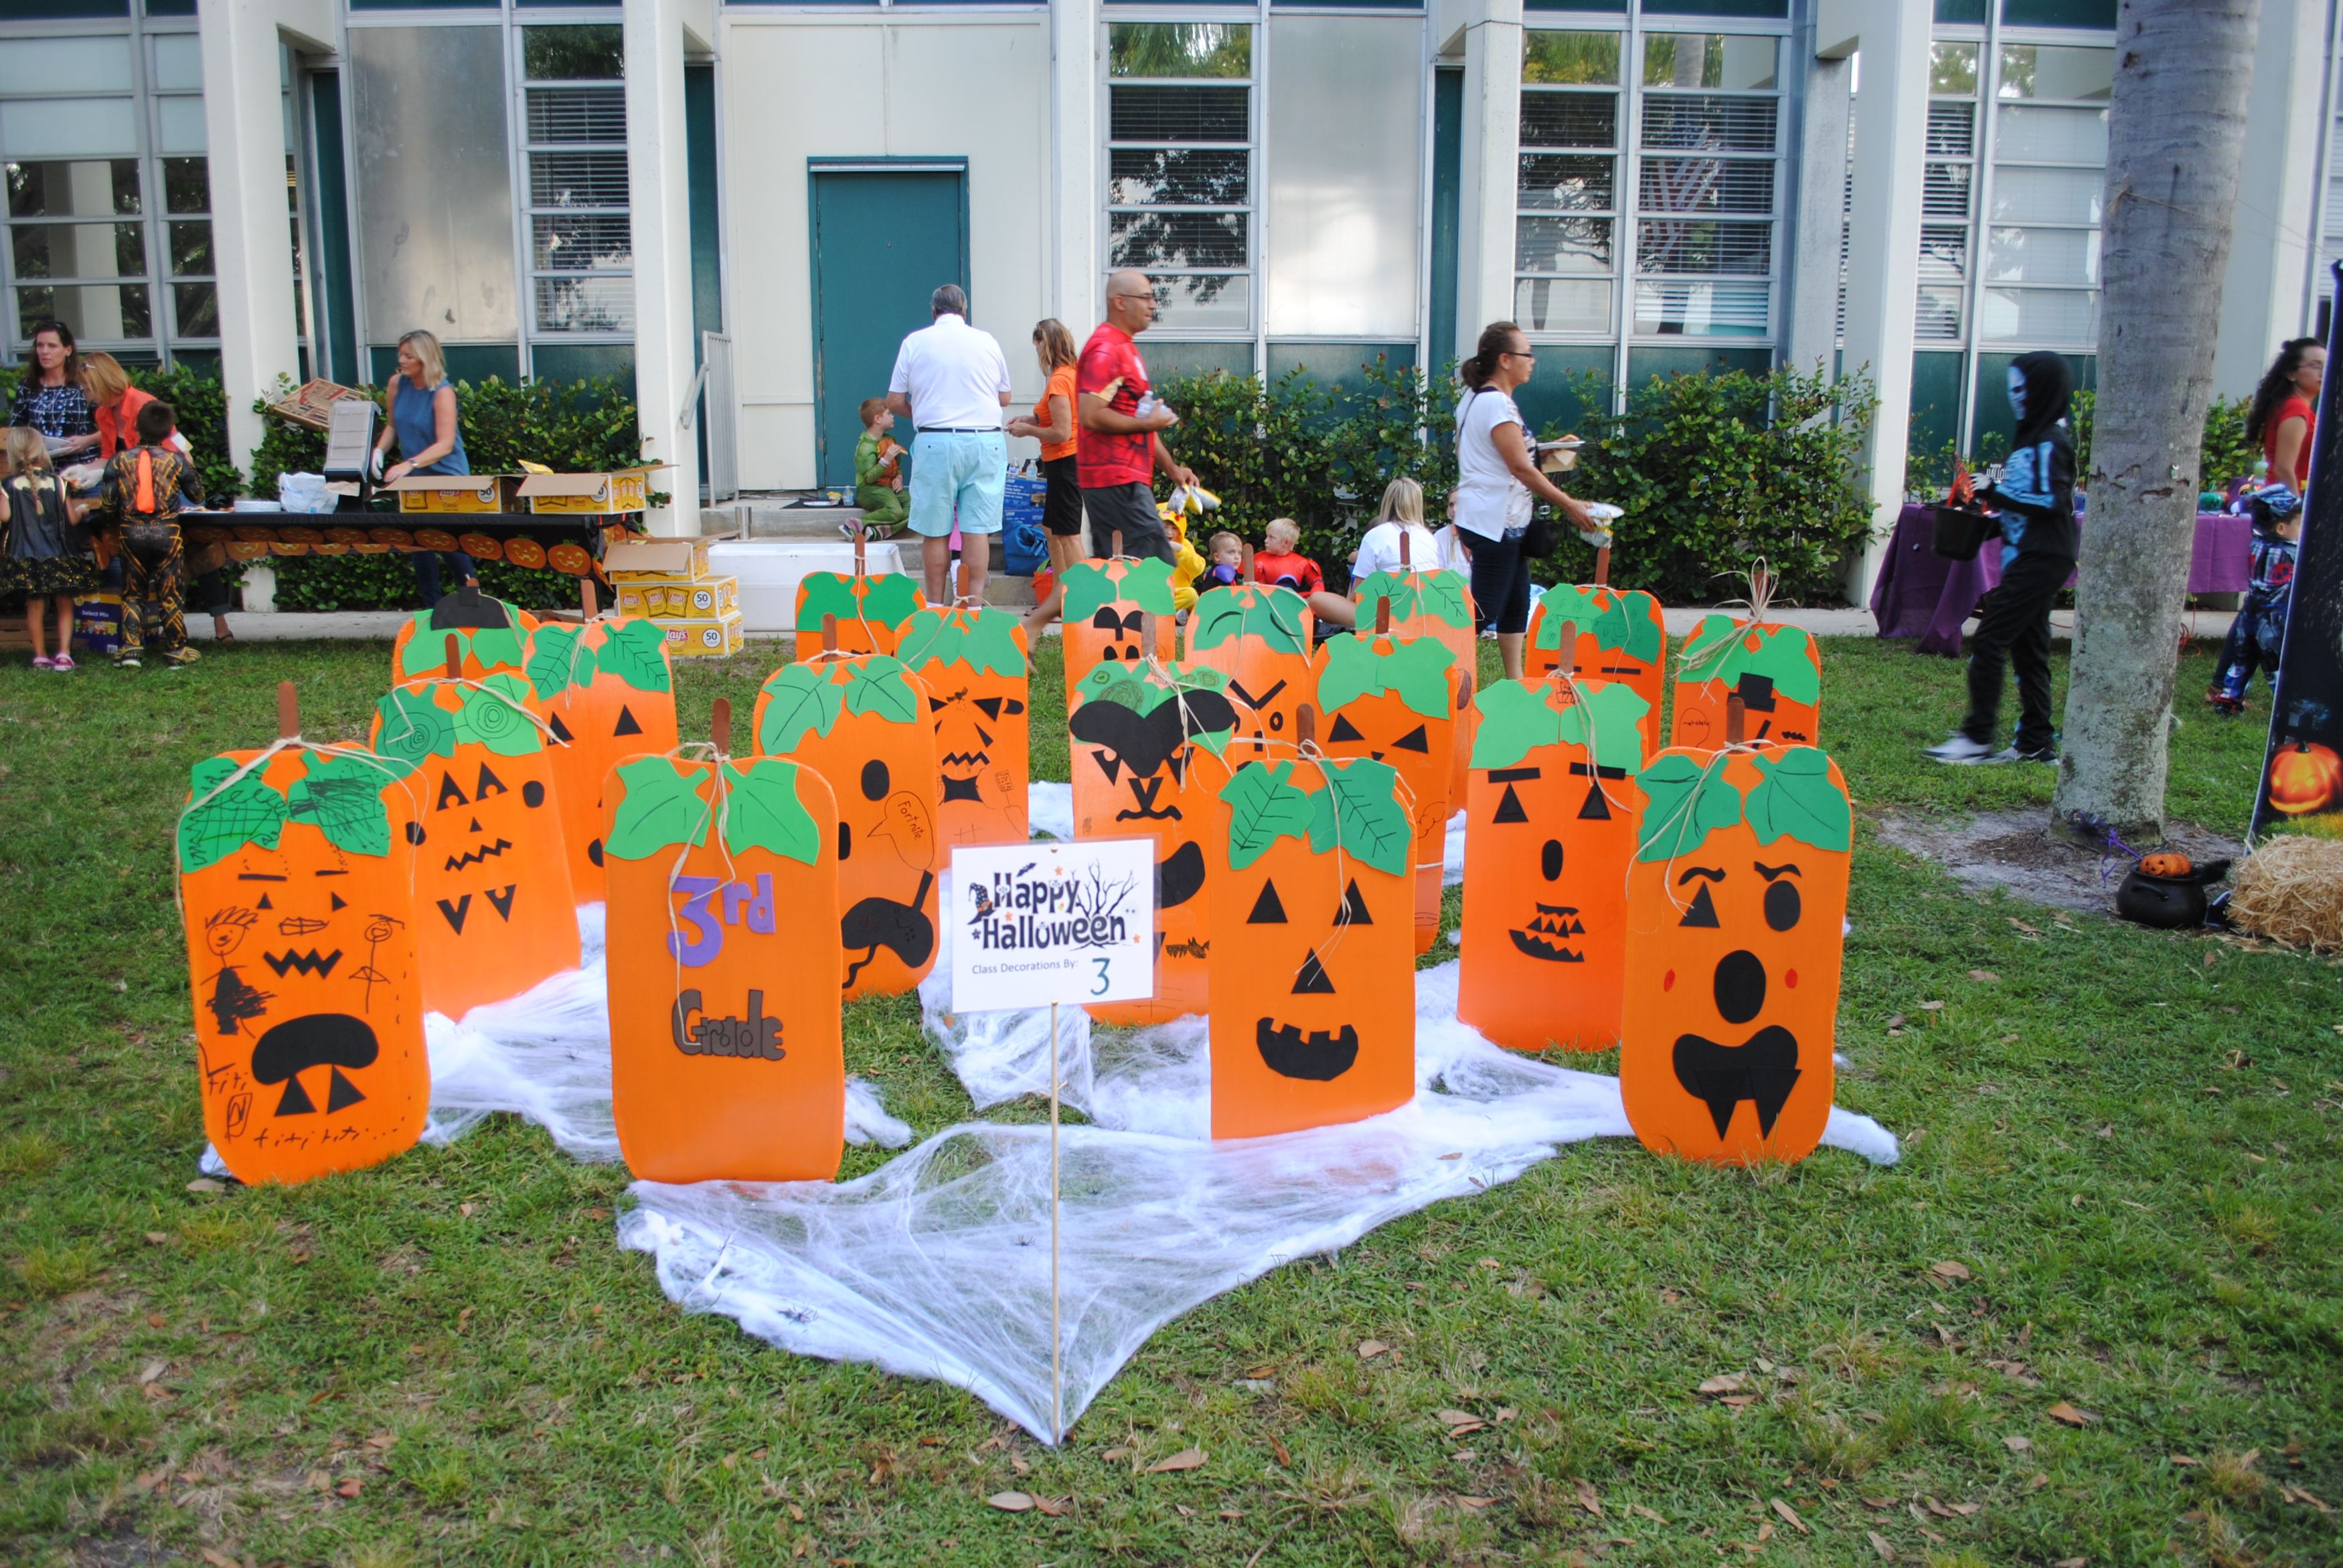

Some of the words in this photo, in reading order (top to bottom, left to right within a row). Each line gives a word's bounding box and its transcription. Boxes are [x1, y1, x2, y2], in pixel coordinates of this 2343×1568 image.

[1986, 468, 2007, 480] HALLO
[697, 594, 708, 602] 50
[706, 632, 718, 640] 50
[897, 800, 925, 841] Fortnite
[993, 872, 1080, 915] Happy
[666, 872, 777, 968] 3rd
[982, 915, 1126, 950] Halloween
[972, 964, 998, 975] Class
[1000, 961, 1061, 973] Decorations
[1064, 959, 1078, 969] By:
[1090, 958, 1111, 996] 3
[671, 988, 787, 1061] Grade
